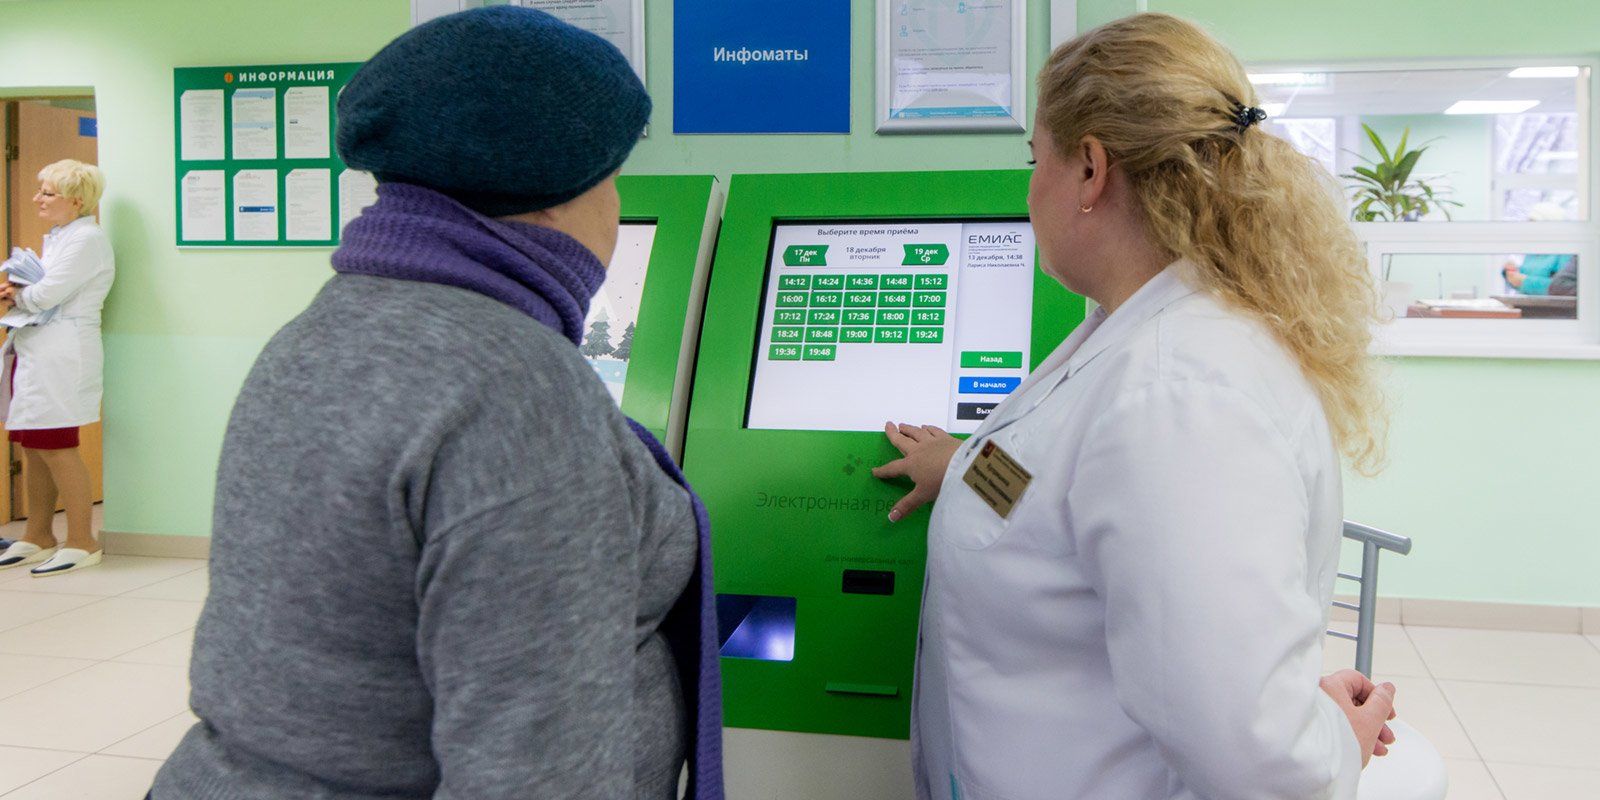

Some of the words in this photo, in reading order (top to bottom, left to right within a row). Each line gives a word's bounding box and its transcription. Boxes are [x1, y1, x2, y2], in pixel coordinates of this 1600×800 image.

[714, 47, 808, 65] Инфоматы
[239, 70, 334, 82] ИНФОРМАЦИЯ
[817, 228, 858, 237] Выберите
[886, 228, 919, 236] приёма
[968, 234, 1022, 244] ЕМИАС
[849, 253, 880, 261] вторник
[920, 255, 931, 263] Ср
[881, 330, 902, 338] 19:12
[755, 492, 870, 512] Электронная
